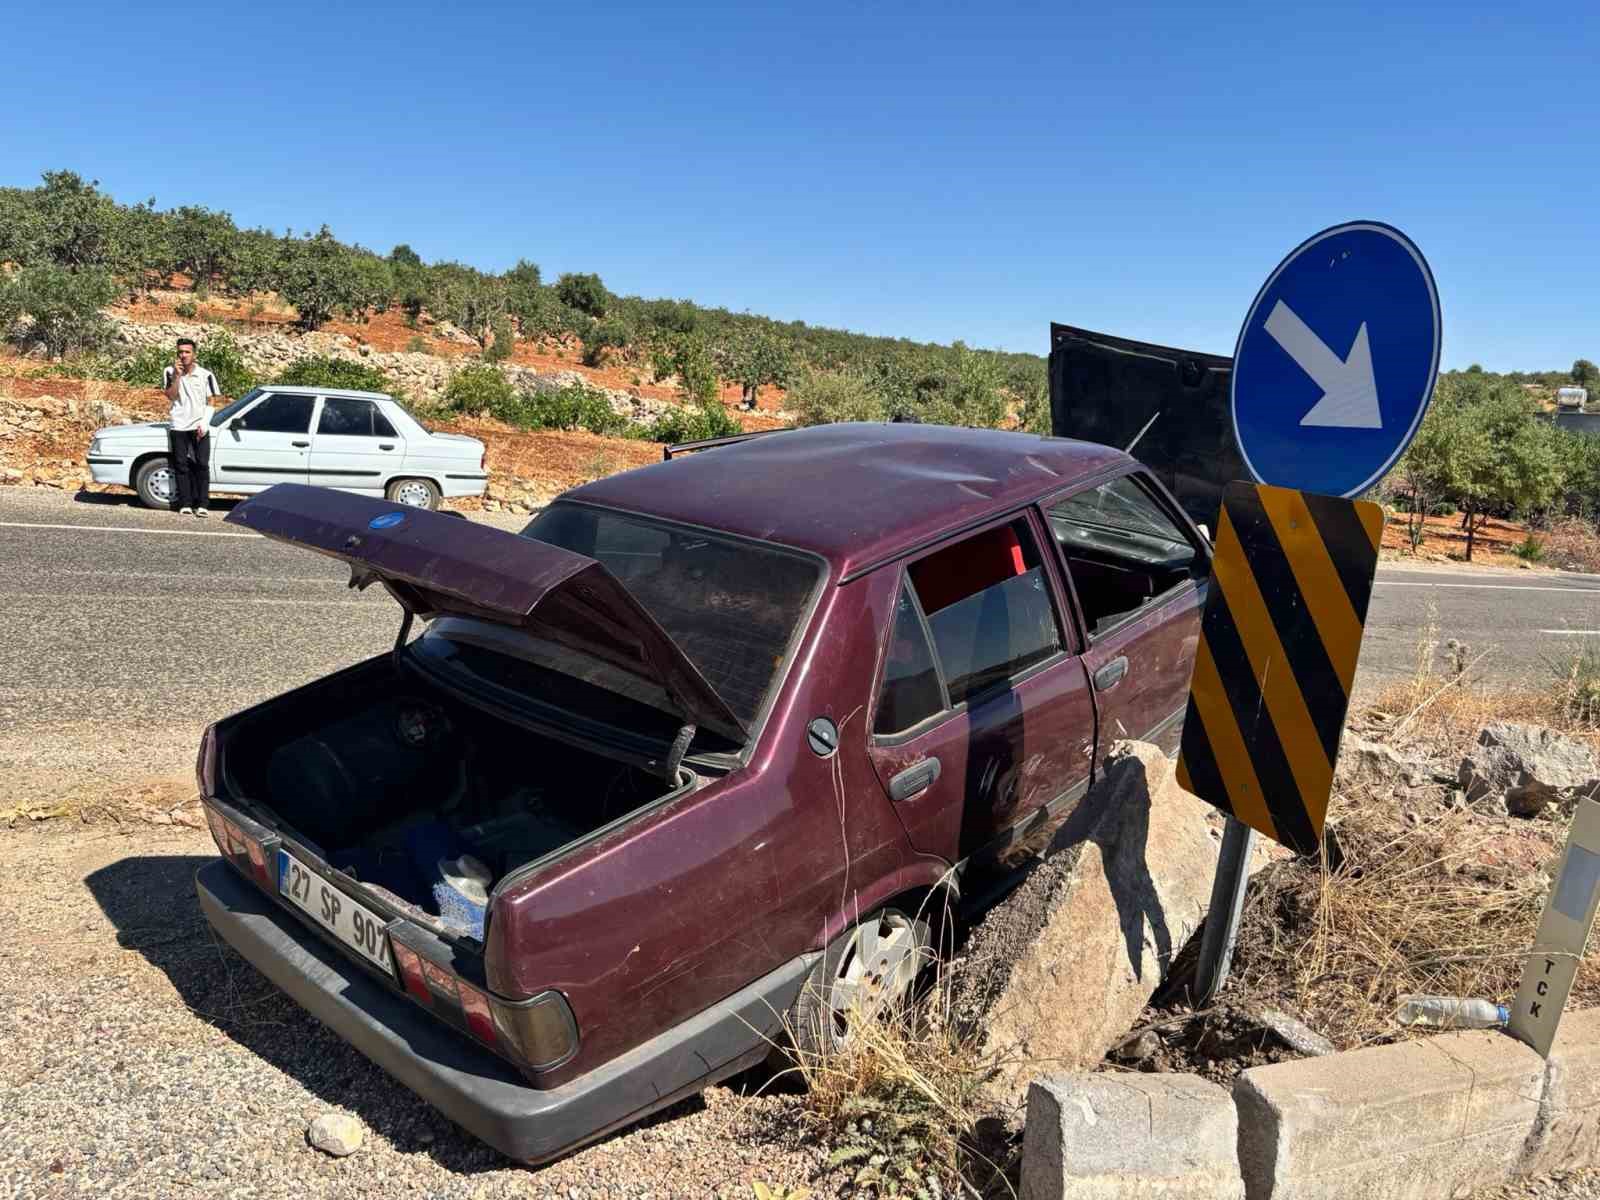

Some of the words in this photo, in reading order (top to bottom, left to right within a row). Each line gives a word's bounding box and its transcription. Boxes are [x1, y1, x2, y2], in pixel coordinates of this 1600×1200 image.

[291, 864, 311, 903] 27
[320, 886, 342, 926] SP
[353, 910, 388, 961] 907
[1530, 959, 1555, 1018] TCK
